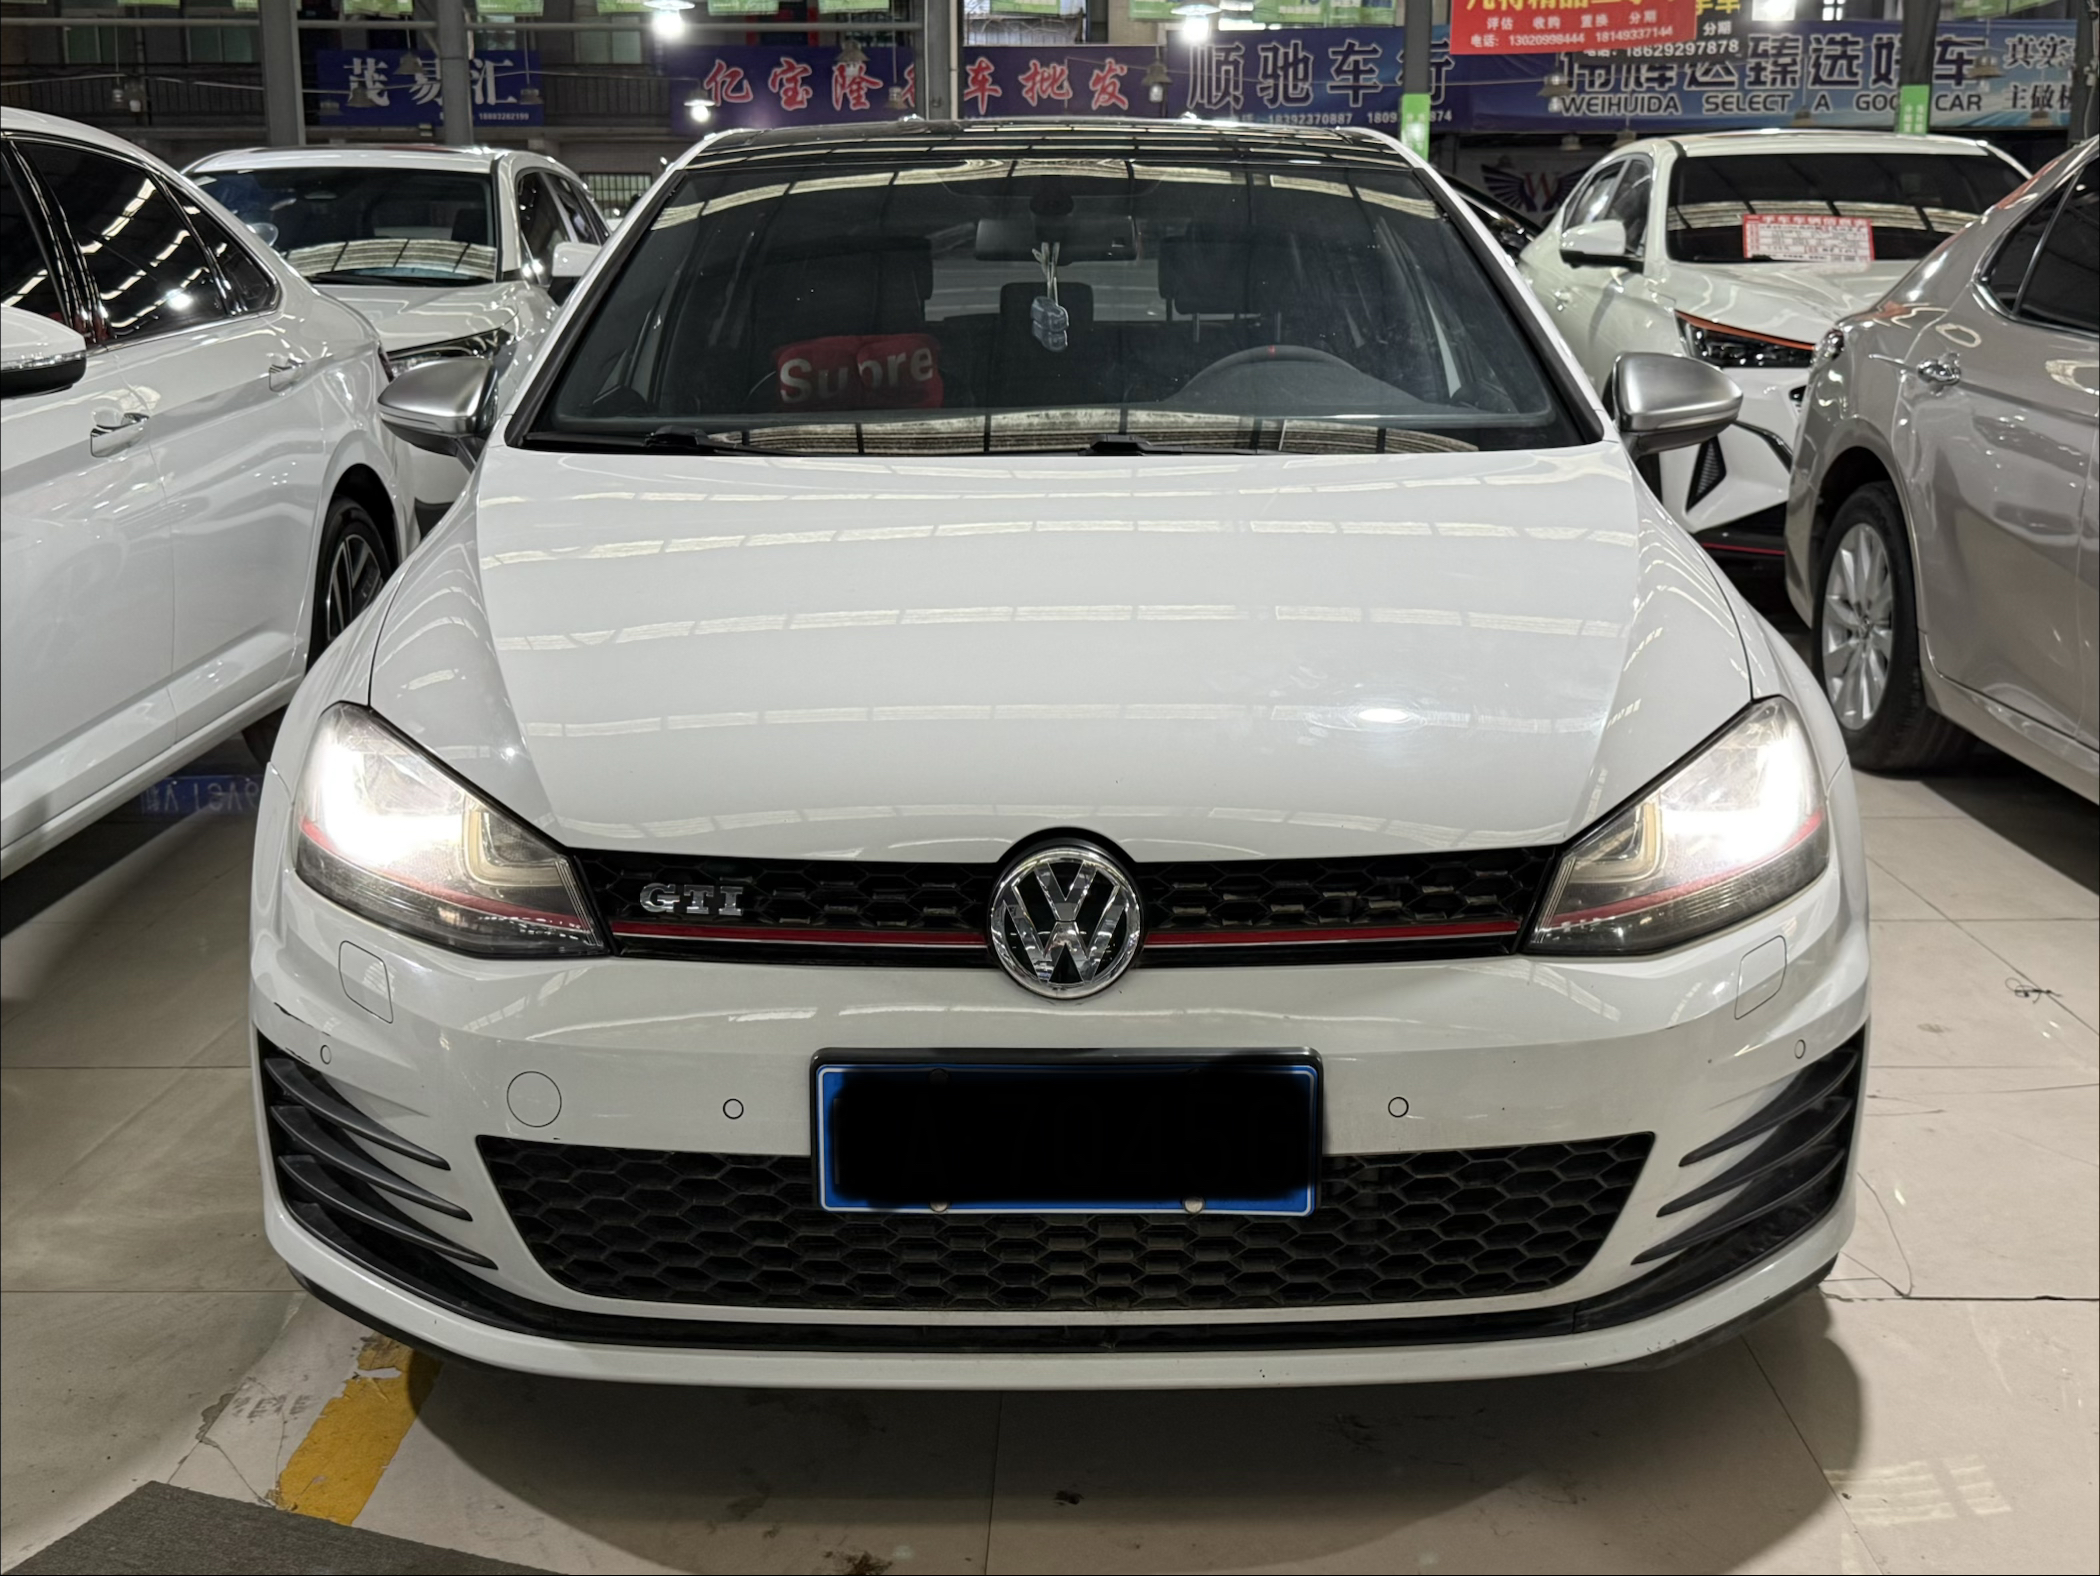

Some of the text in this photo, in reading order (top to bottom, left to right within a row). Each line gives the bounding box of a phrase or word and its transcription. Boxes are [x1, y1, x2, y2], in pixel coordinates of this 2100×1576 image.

[1486, 17, 1514, 31] 评估
[1532, 16, 1561, 29] 收购
[1629, 10, 1657, 25] 分期
[1703, 20, 1732, 36] 分期
[703, 57, 1129, 116] 亿宝隆车批发
[1561, 92, 1983, 115] WEIHUIDA SELECT A GO CAR
[1367, 109, 1453, 124] 1809874
[639, 882, 745, 917] GTI
